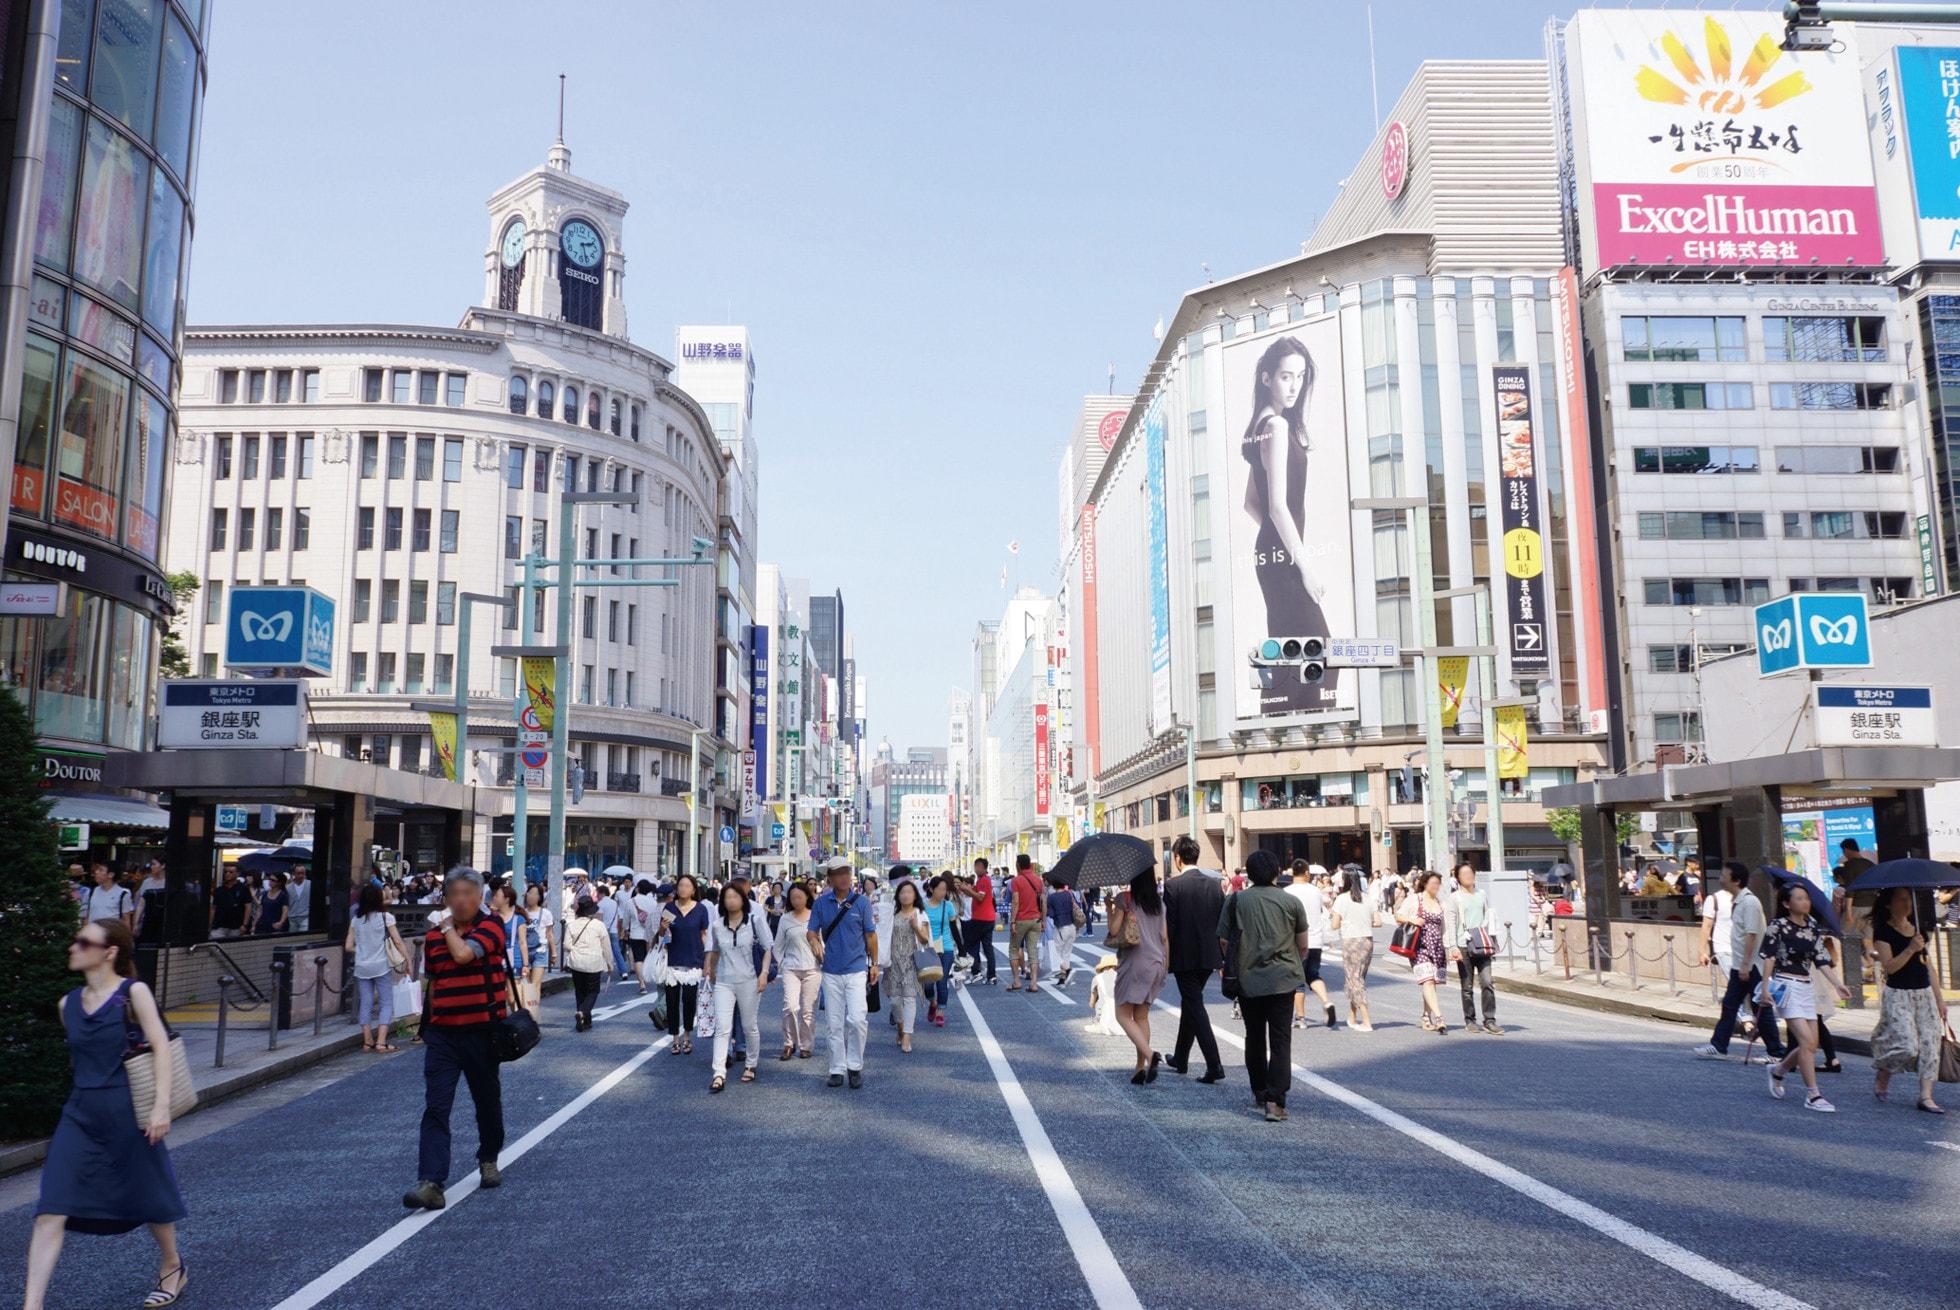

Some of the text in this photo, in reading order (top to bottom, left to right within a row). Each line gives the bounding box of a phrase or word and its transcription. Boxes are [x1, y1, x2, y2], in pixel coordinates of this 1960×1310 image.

[1616, 194, 1858, 236] ExcelHuman
[1684, 240, 1799, 260] EH株式会社
[565, 267, 599, 285] SEIKO
[1559, 277, 1576, 395] MITSUKOSHI
[683, 342, 742, 358] 山野楽器
[1497, 376, 1525, 384] GINZA
[62, 489, 115, 528] SALON
[1082, 510, 1094, 584] MITSUKOSHI
[1272, 546, 1285, 563] is
[23, 540, 86, 573] DOUTOR
[1332, 645, 1394, 656] 銀座四丁目
[787, 625, 799, 695] 教文館
[209, 687, 255, 697] 東京メトロ
[1853, 690, 1894, 699] 東京メトロ
[201, 711, 260, 728] 銀座駅
[1850, 712, 1902, 728] 銀座駅
[201, 729, 259, 740] Ginza Sta.
[1852, 730, 1903, 740] Ginza Sta.
[45, 758, 101, 782] DOUTOR
[911, 797, 941, 809] LIXIL
